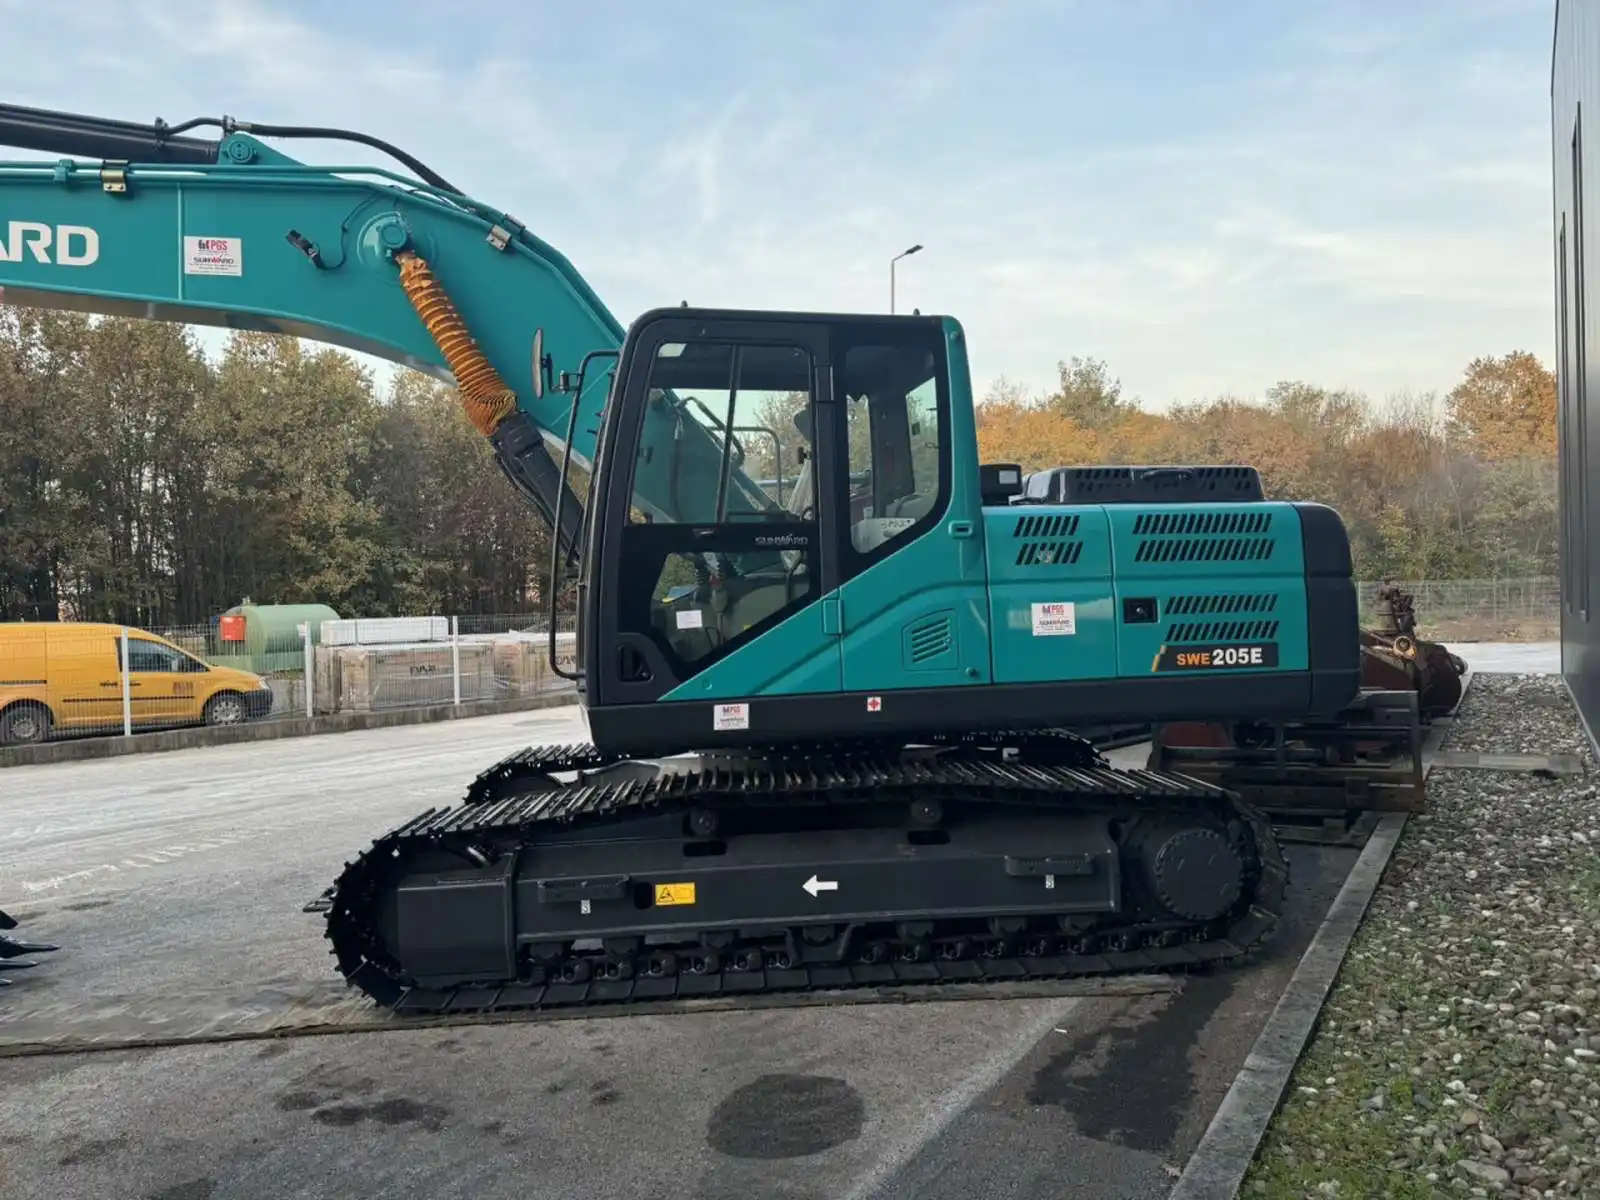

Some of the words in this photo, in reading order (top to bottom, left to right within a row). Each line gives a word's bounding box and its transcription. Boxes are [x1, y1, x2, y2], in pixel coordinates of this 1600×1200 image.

[0, 220, 100, 266] RD
[1176, 653, 1211, 666] SWE
[1212, 647, 1263, 666] 205E
